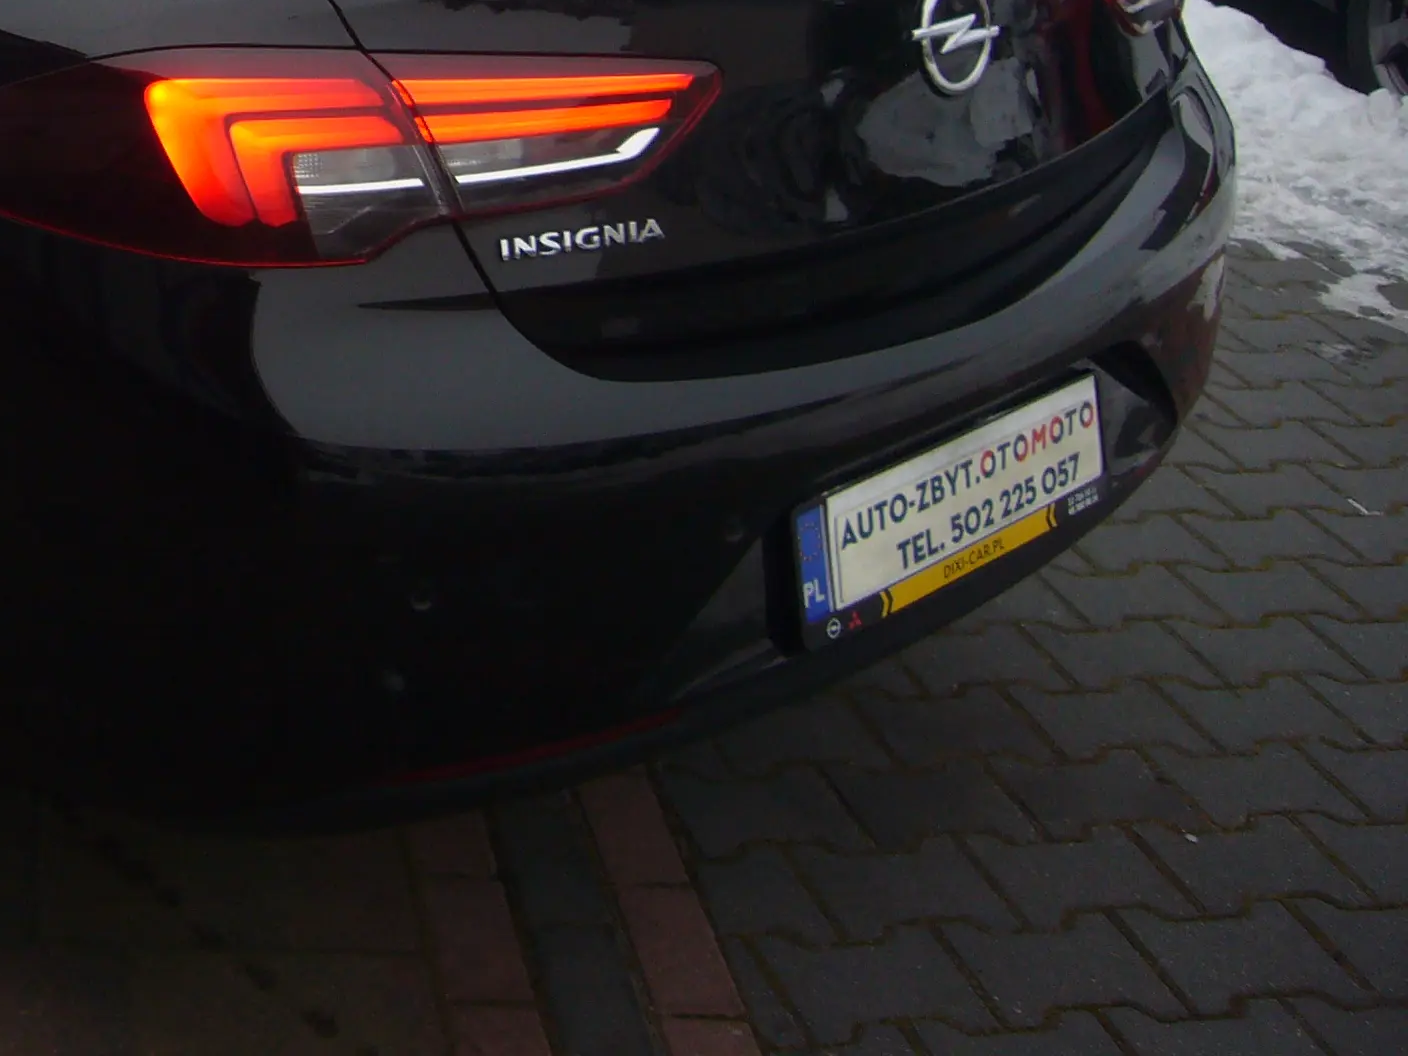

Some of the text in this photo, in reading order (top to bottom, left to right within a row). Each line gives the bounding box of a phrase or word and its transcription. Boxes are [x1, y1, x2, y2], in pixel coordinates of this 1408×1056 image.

[500, 218, 666, 261] INSIGNIA
[896, 530, 945, 570] TEL.
[950, 500, 995, 544] 502
[999, 476, 1037, 520] 225
[803, 578, 825, 608] PL
